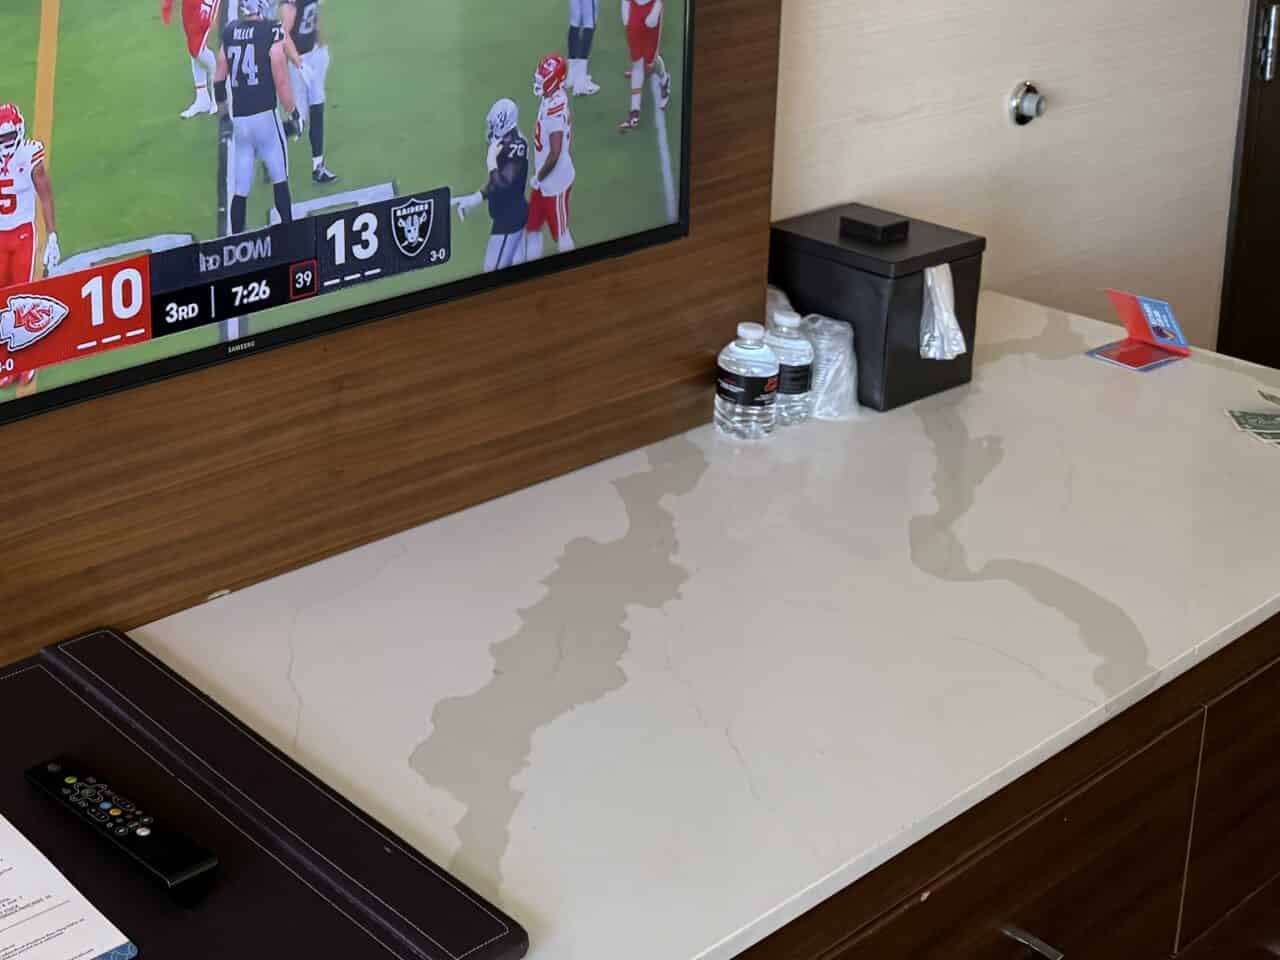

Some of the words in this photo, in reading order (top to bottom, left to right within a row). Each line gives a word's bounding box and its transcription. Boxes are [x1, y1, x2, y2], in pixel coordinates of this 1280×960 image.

[227, 43, 259, 87] 74
[326, 212, 379, 265] 13
[429, 248, 446, 262] 3-0
[231, 279, 271, 307] 7:26
[295, 270, 313, 289] 39
[81, 268, 143, 327] 10
[165, 302, 199, 324] 3RD
